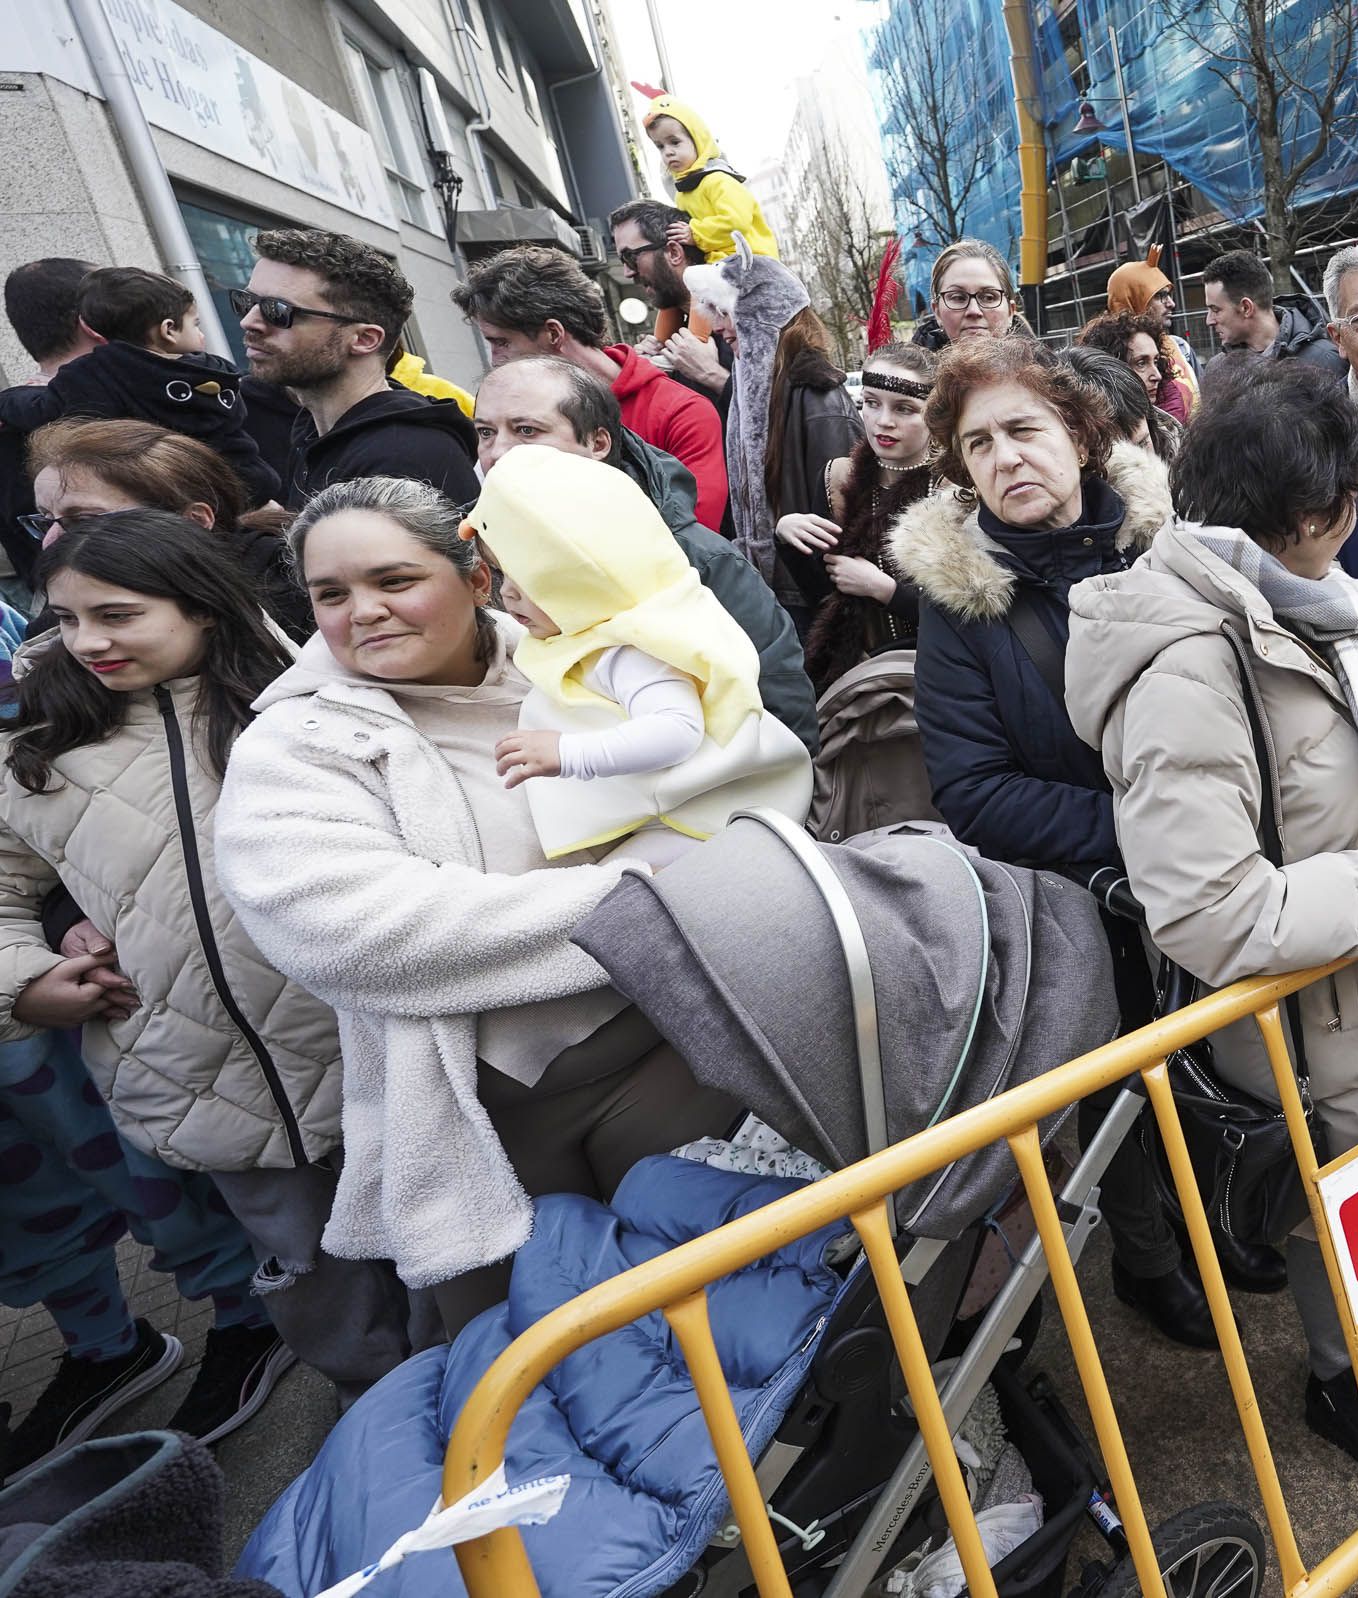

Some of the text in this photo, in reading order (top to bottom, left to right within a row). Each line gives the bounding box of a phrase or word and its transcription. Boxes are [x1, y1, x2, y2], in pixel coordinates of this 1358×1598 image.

[107, 0, 209, 72] mpleadas
[152, 56, 223, 129] Hogar
[872, 1461, 931, 1553] Mercedes-Benz
